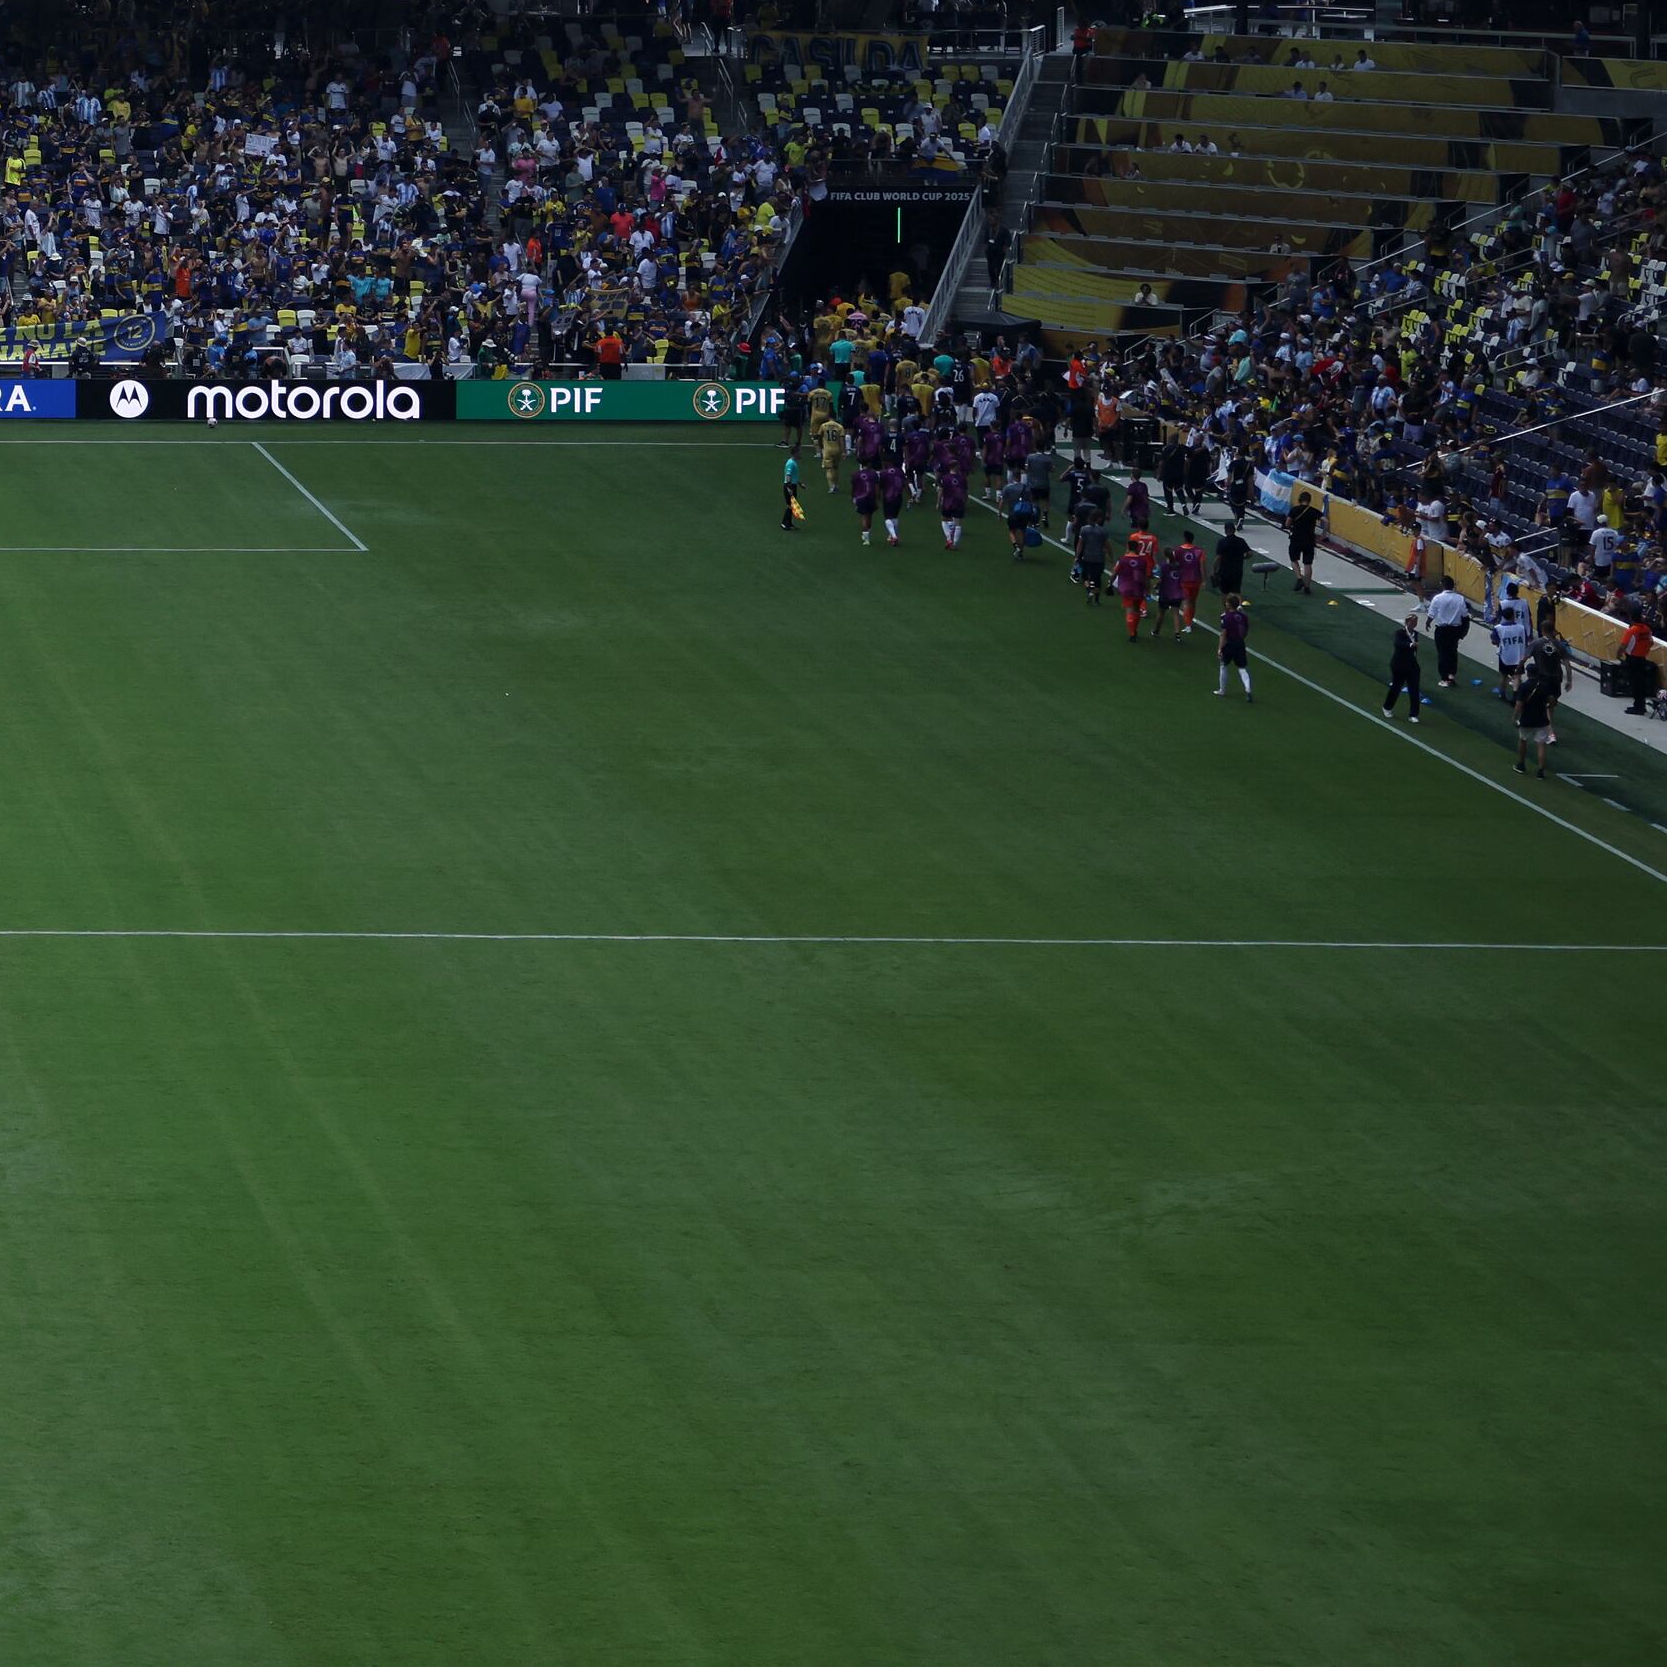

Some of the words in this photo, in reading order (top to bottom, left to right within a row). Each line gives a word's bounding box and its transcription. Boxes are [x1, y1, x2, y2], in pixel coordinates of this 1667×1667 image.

[830, 191, 854, 201] FIFA
[856, 191, 881, 201] CLUB
[883, 191, 918, 201] WORLD
[922, 191, 943, 201] CUP
[945, 191, 969, 201] 2025
[64, 319, 105, 338] LA
[128, 325, 143, 339] 12
[953, 369, 965, 382] 26
[187, 379, 420, 419] motorola
[550, 387, 603, 413] PIF
[735, 387, 786, 413] PIF
[849, 392, 855, 406] 7
[890, 440, 897, 453] 4
[1139, 540, 1153, 556] 24
[1502, 636, 1525, 646] FIFA
